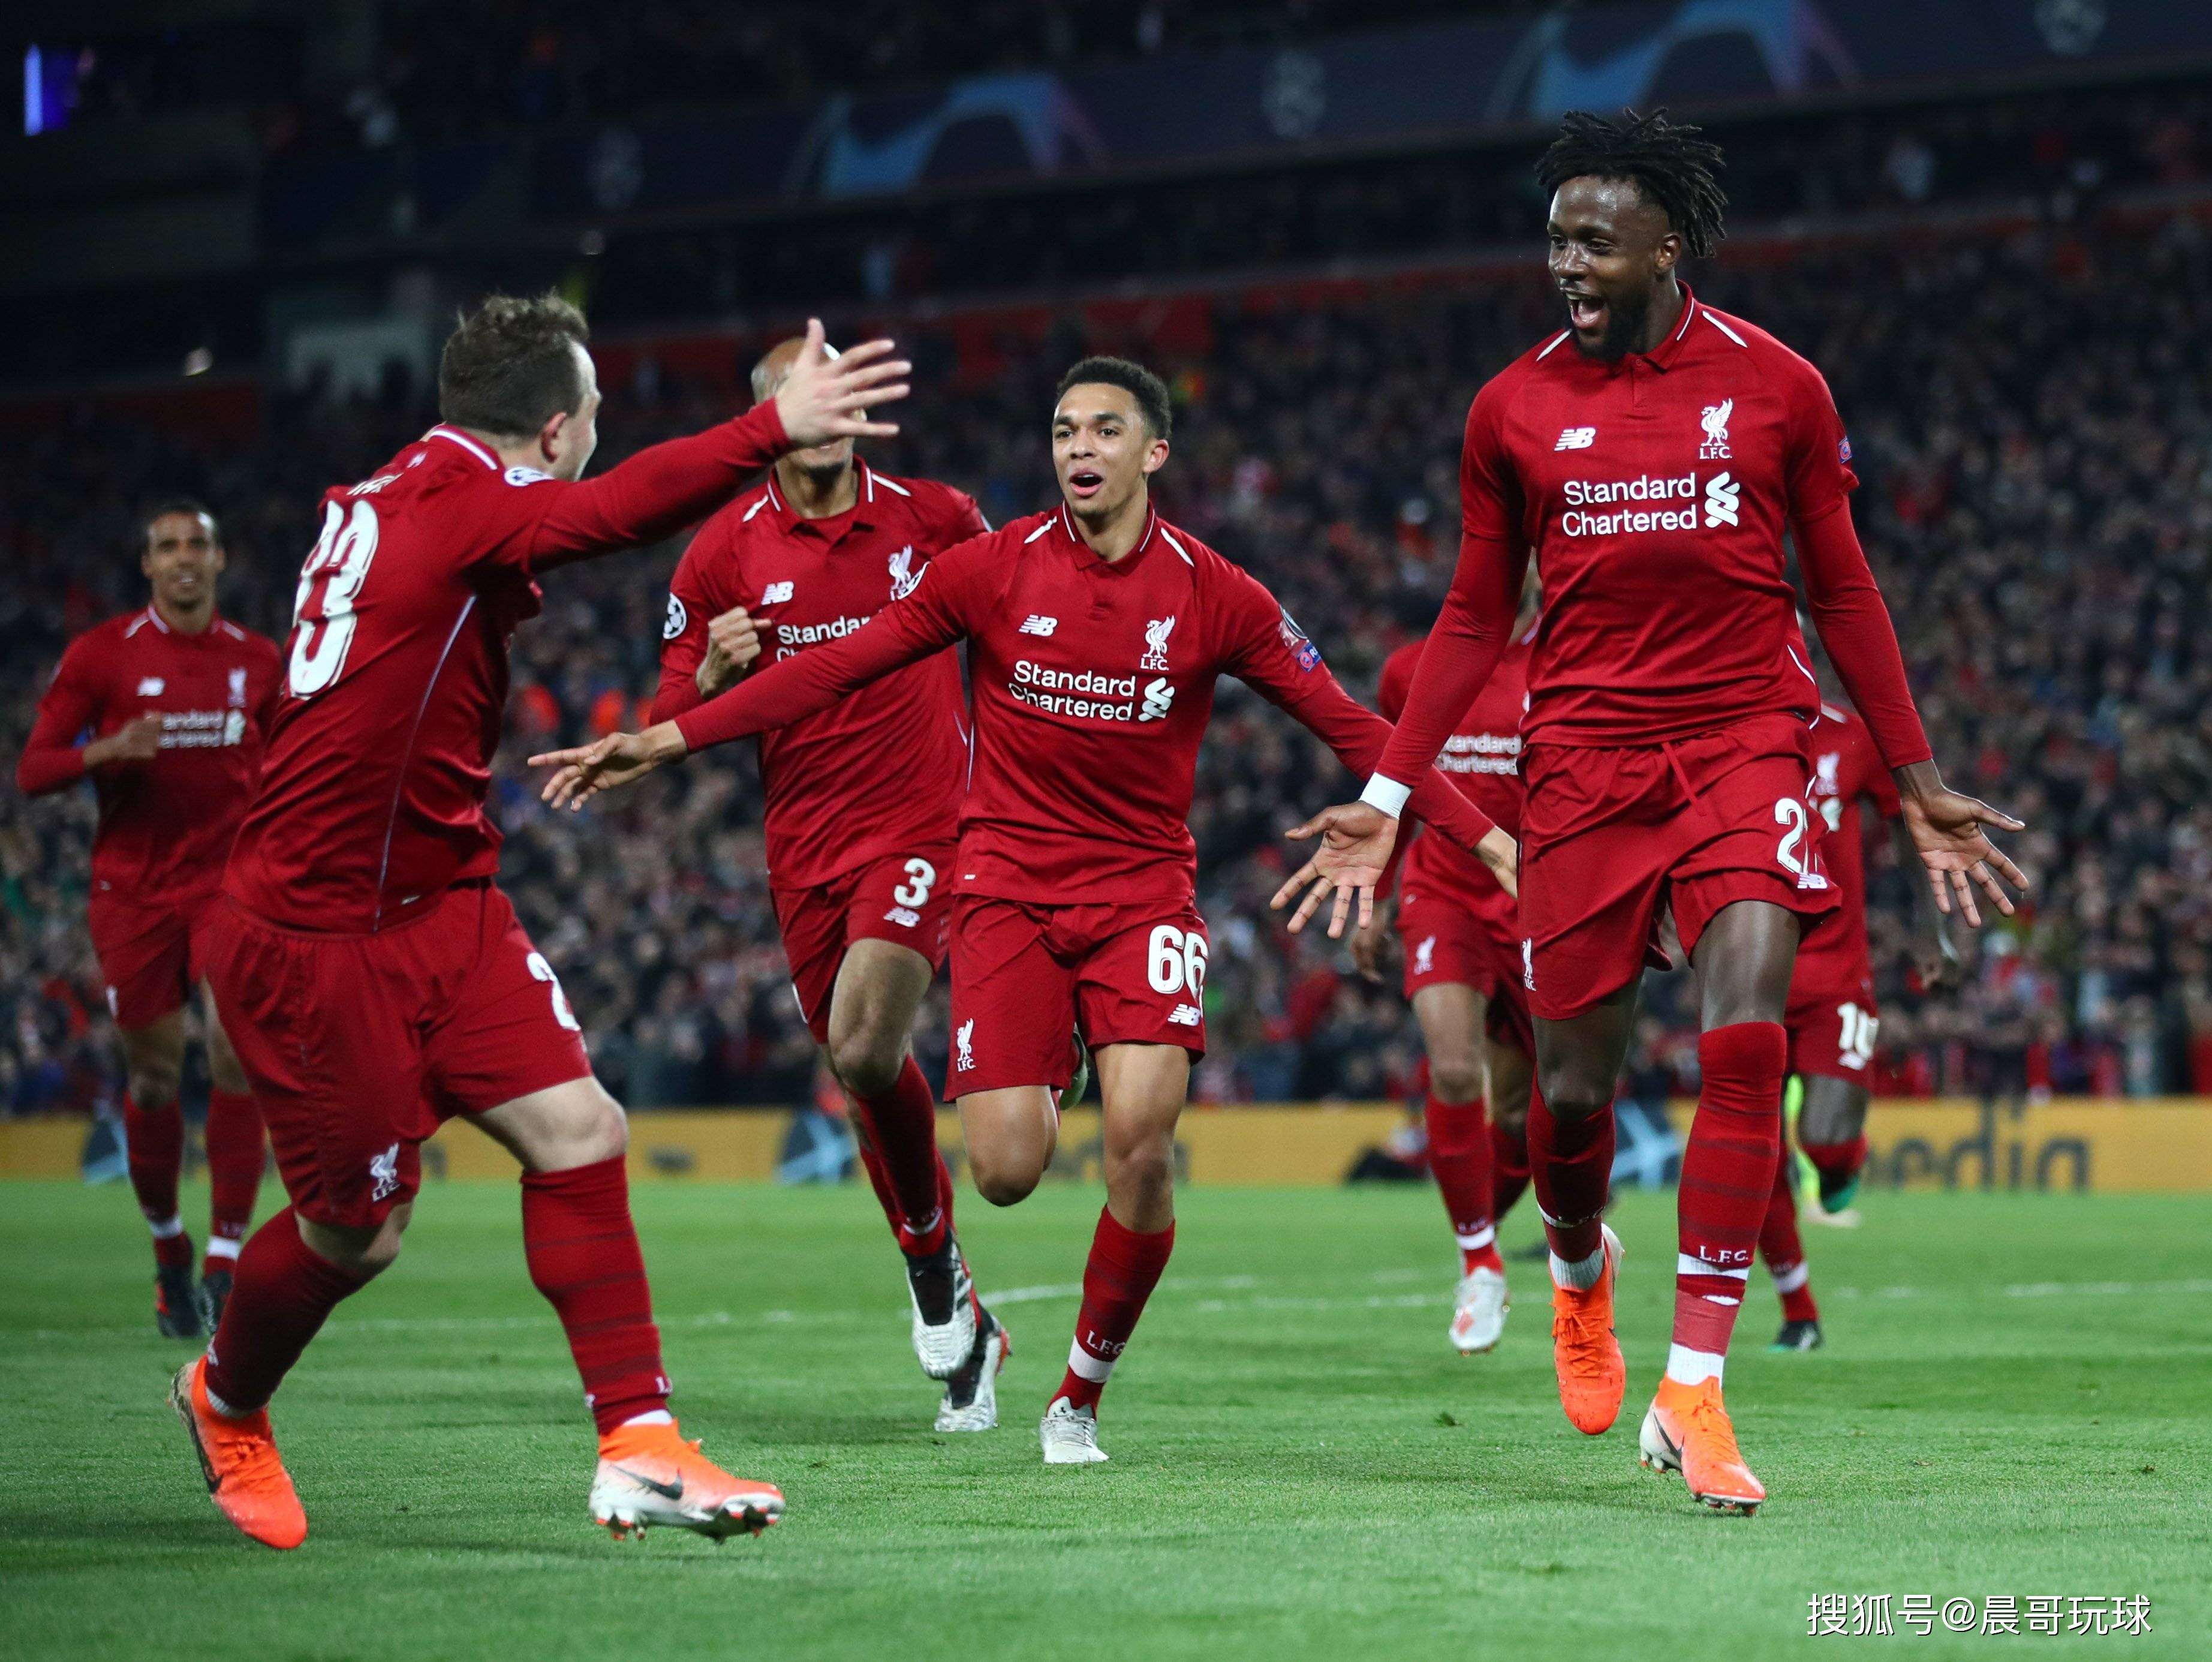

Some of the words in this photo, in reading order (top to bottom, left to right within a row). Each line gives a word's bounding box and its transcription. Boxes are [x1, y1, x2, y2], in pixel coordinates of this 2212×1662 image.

[1563, 472, 1696, 506] Standard
[1562, 504, 1697, 537] Chartered
[777, 615, 883, 645] Standar
[1014, 660, 1136, 696] Standard
[1009, 683, 1133, 721] Chartered
[894, 857, 937, 909] 3
[1148, 924, 1209, 1009] 66
[1837, 1002, 1880, 1061] 10
